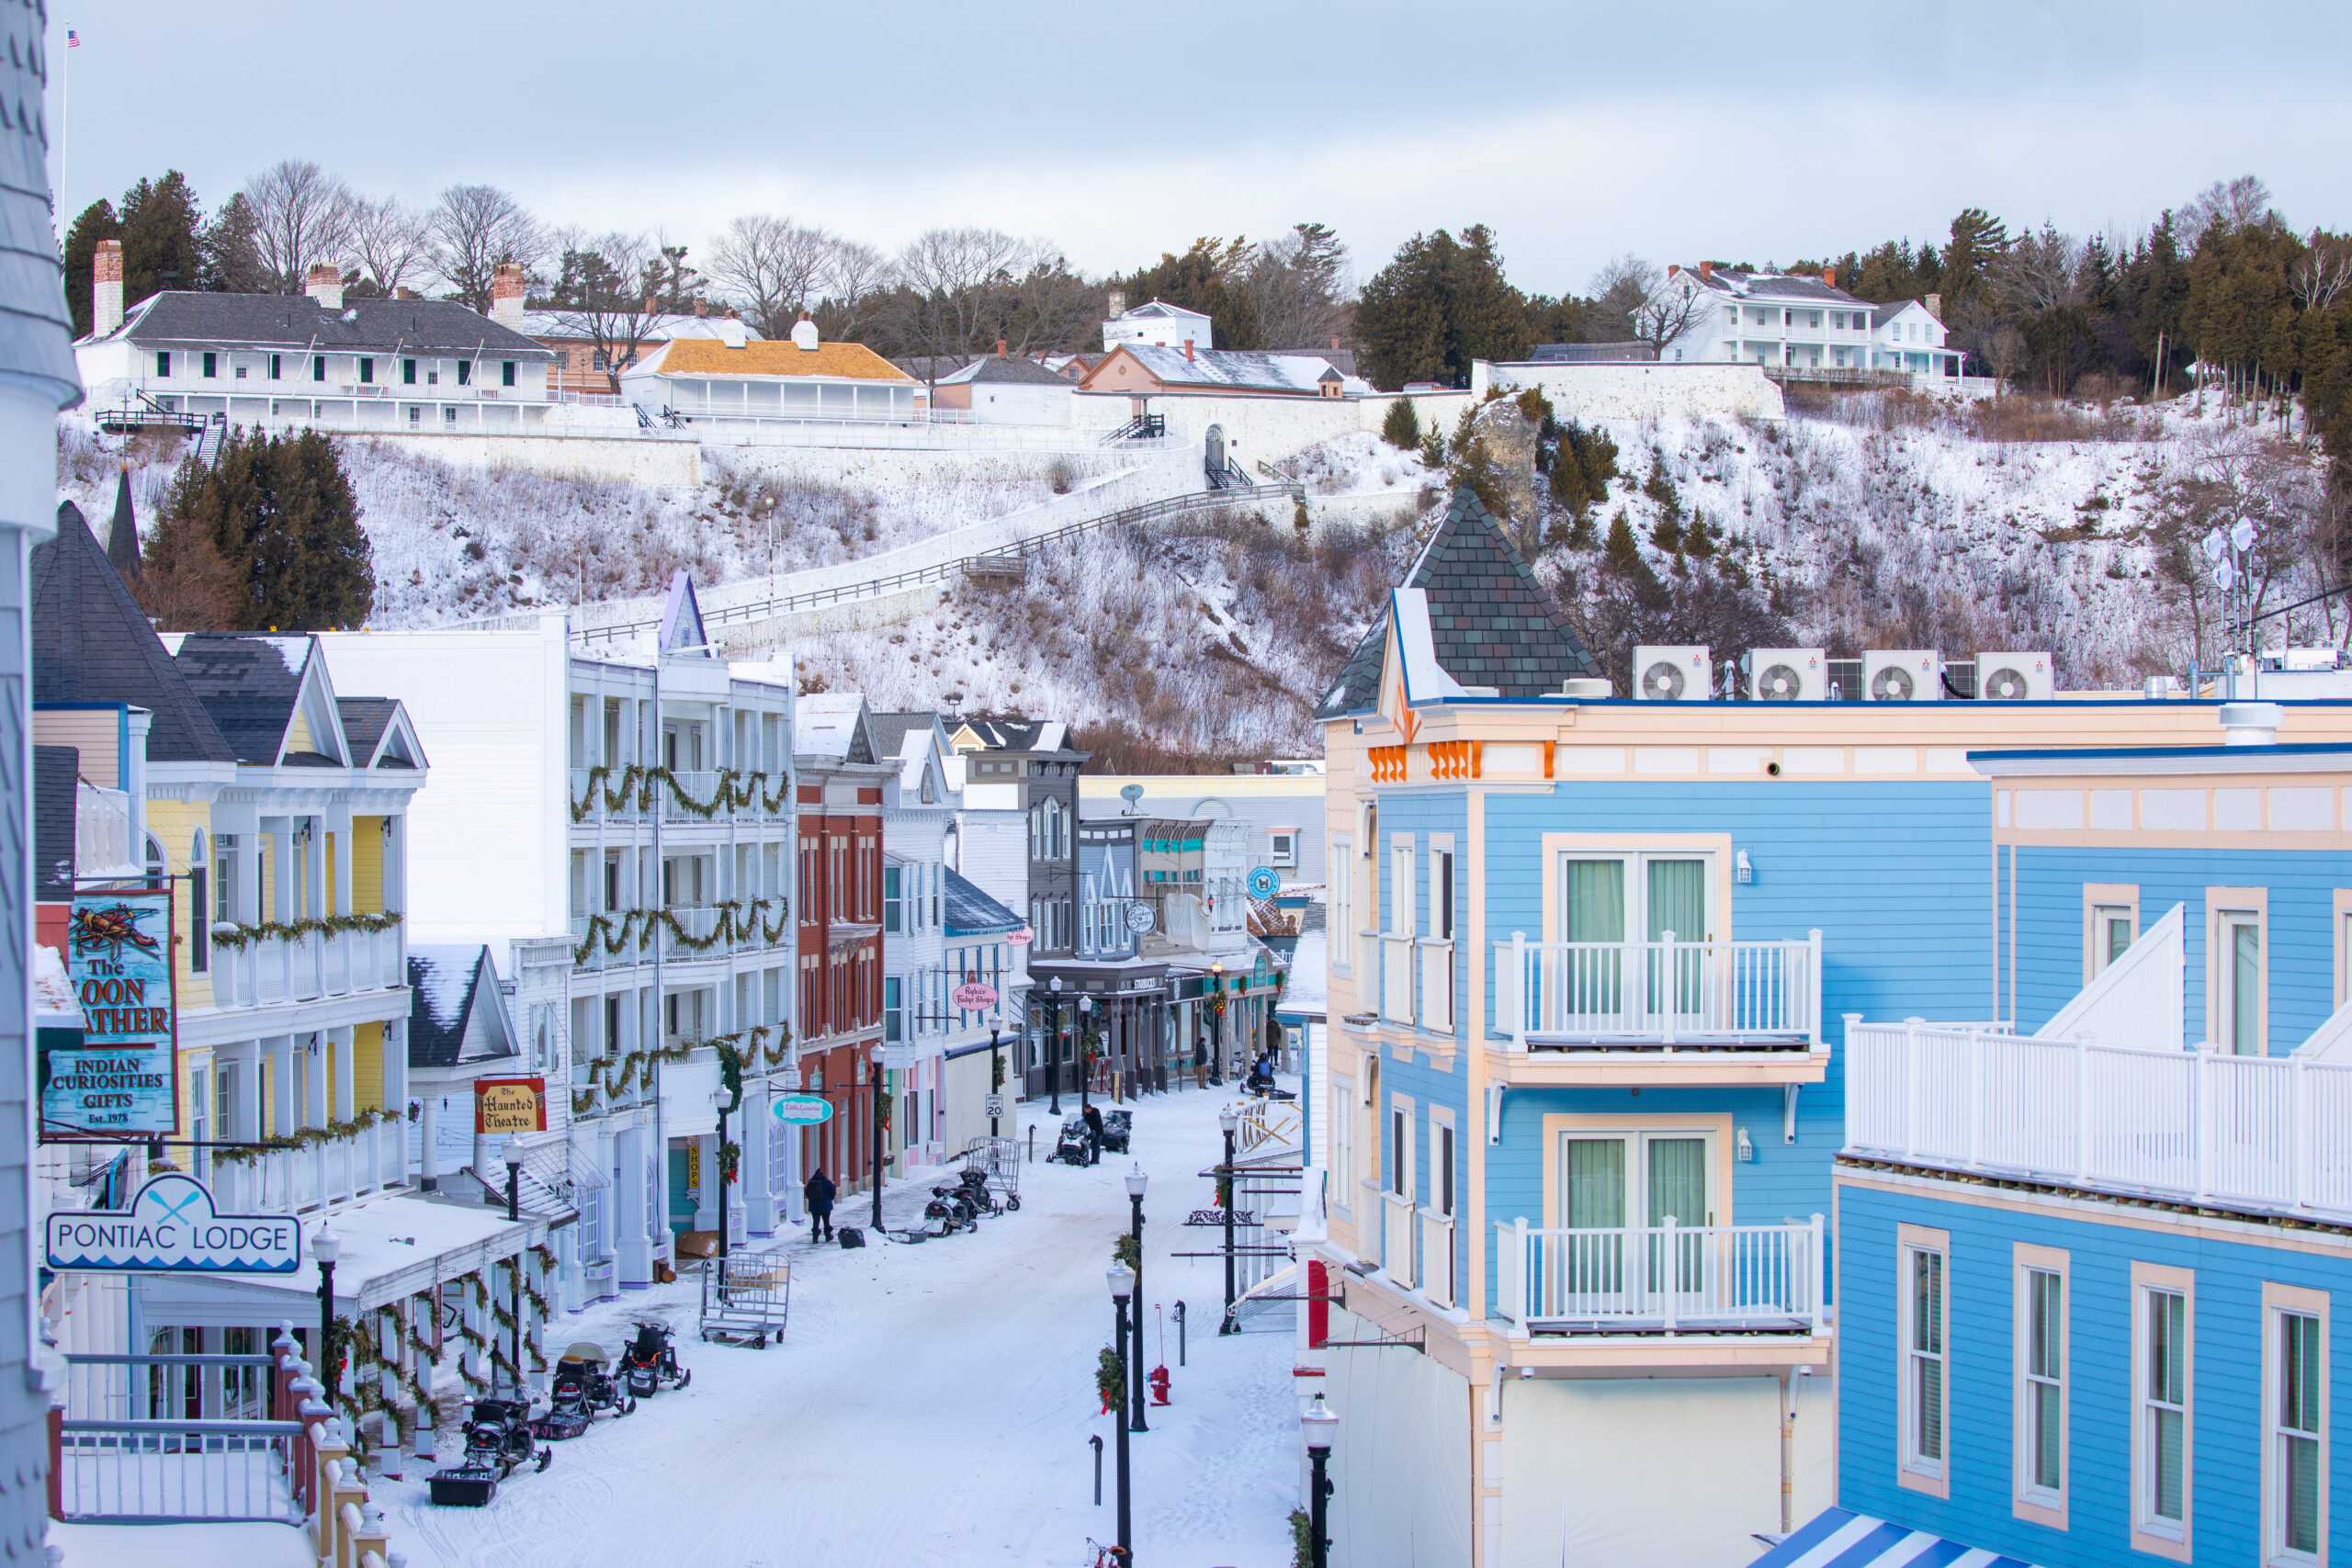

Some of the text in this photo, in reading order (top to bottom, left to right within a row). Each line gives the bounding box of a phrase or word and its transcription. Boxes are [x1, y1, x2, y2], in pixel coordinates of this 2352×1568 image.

[87, 959, 124, 975] The
[1134, 977, 1156, 990] STARBUCKS
[71, 978, 145, 1006] OON
[965, 986, 986, 997] Ryba's
[976, 996, 994, 1005] Shops
[84, 1008, 169, 1033] ATHER
[74, 1058, 140, 1074] INDIAN
[51, 1074, 163, 1089] CURIOSITIES
[83, 1093, 133, 1108] GIFTS
[484, 1096, 533, 1111] Haunted
[88, 1113, 129, 1123] Est. 1978
[988, 1107, 1001, 1115] 20
[485, 1113, 531, 1128] Theatre
[59, 1224, 288, 1250] PONTIAC LODGE
